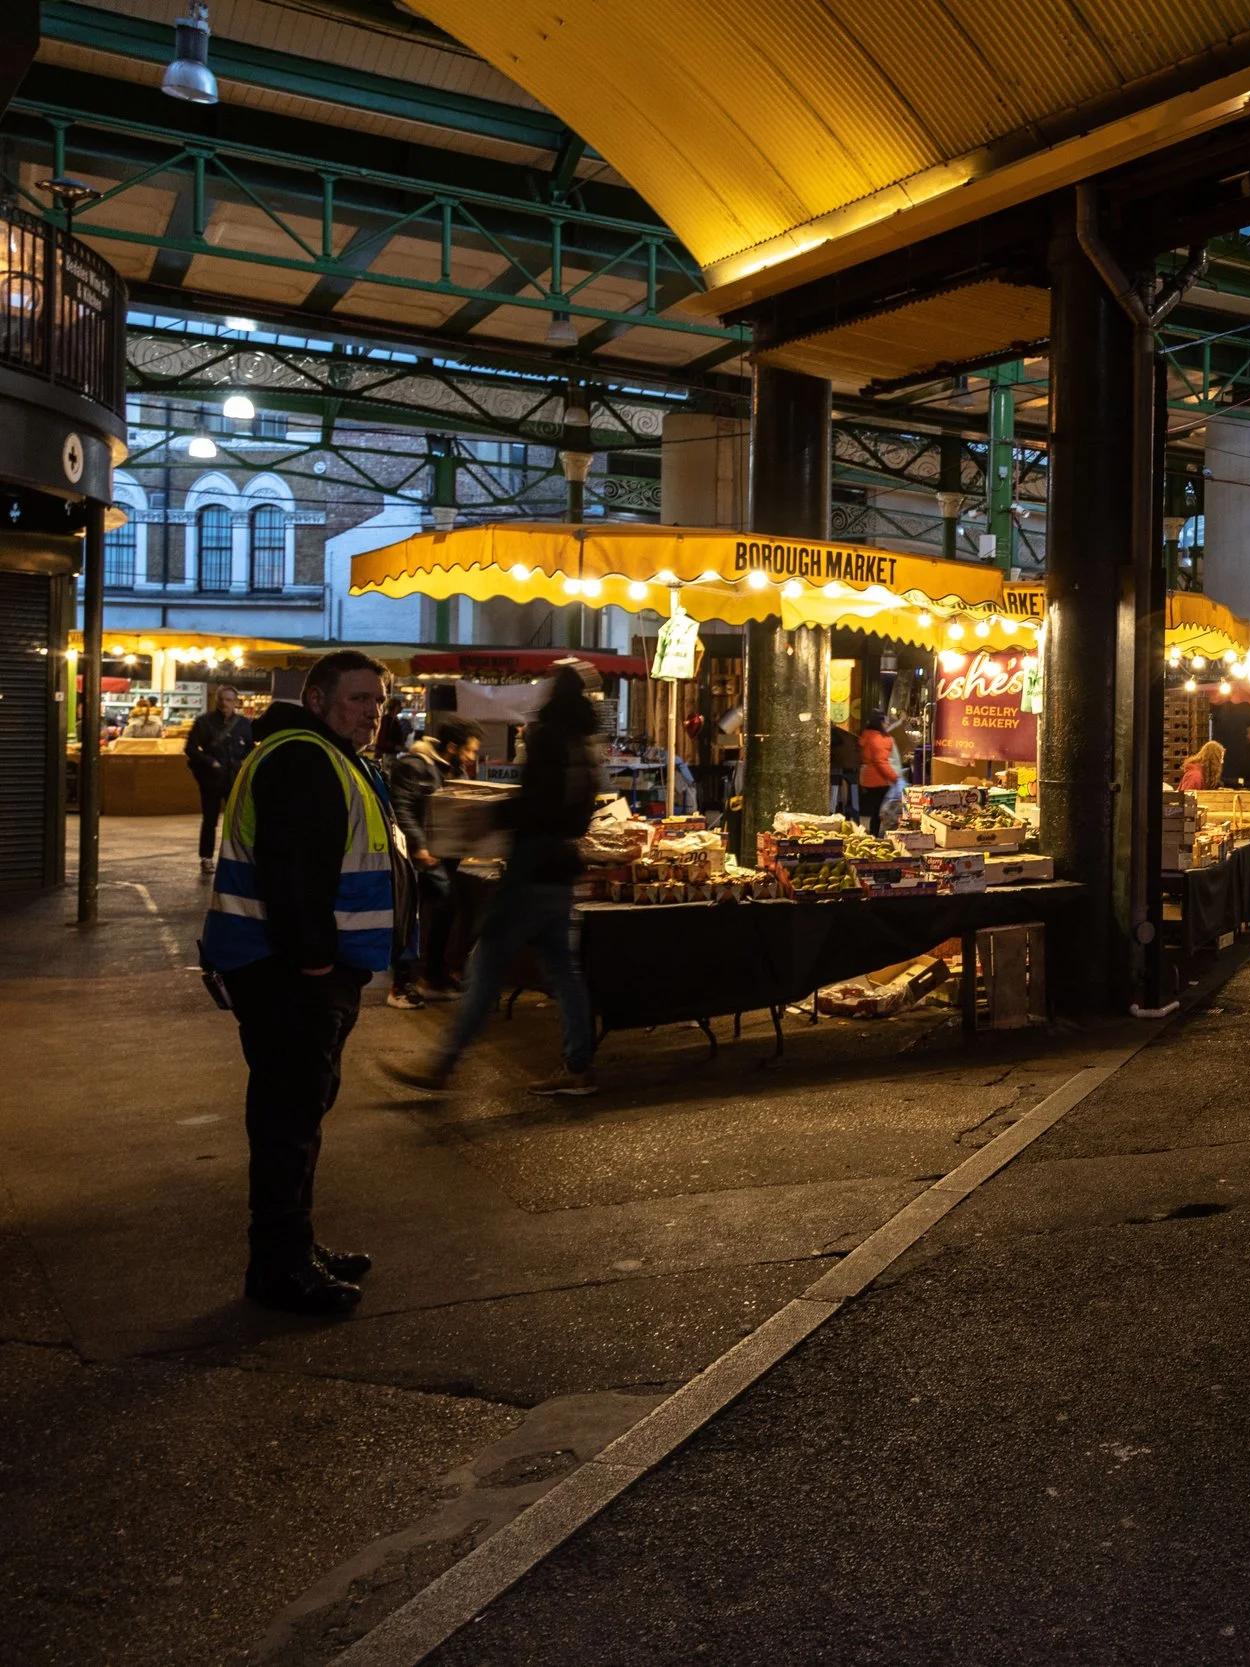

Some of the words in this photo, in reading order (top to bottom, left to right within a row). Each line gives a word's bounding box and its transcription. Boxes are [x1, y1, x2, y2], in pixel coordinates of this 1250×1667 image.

[735, 542, 821, 577] BOROUGH
[825, 550, 897, 585] MARKET
[965, 705, 1018, 717] BAGELRY
[961, 717, 969, 726] &
[973, 718, 1019, 729] BAKERY
